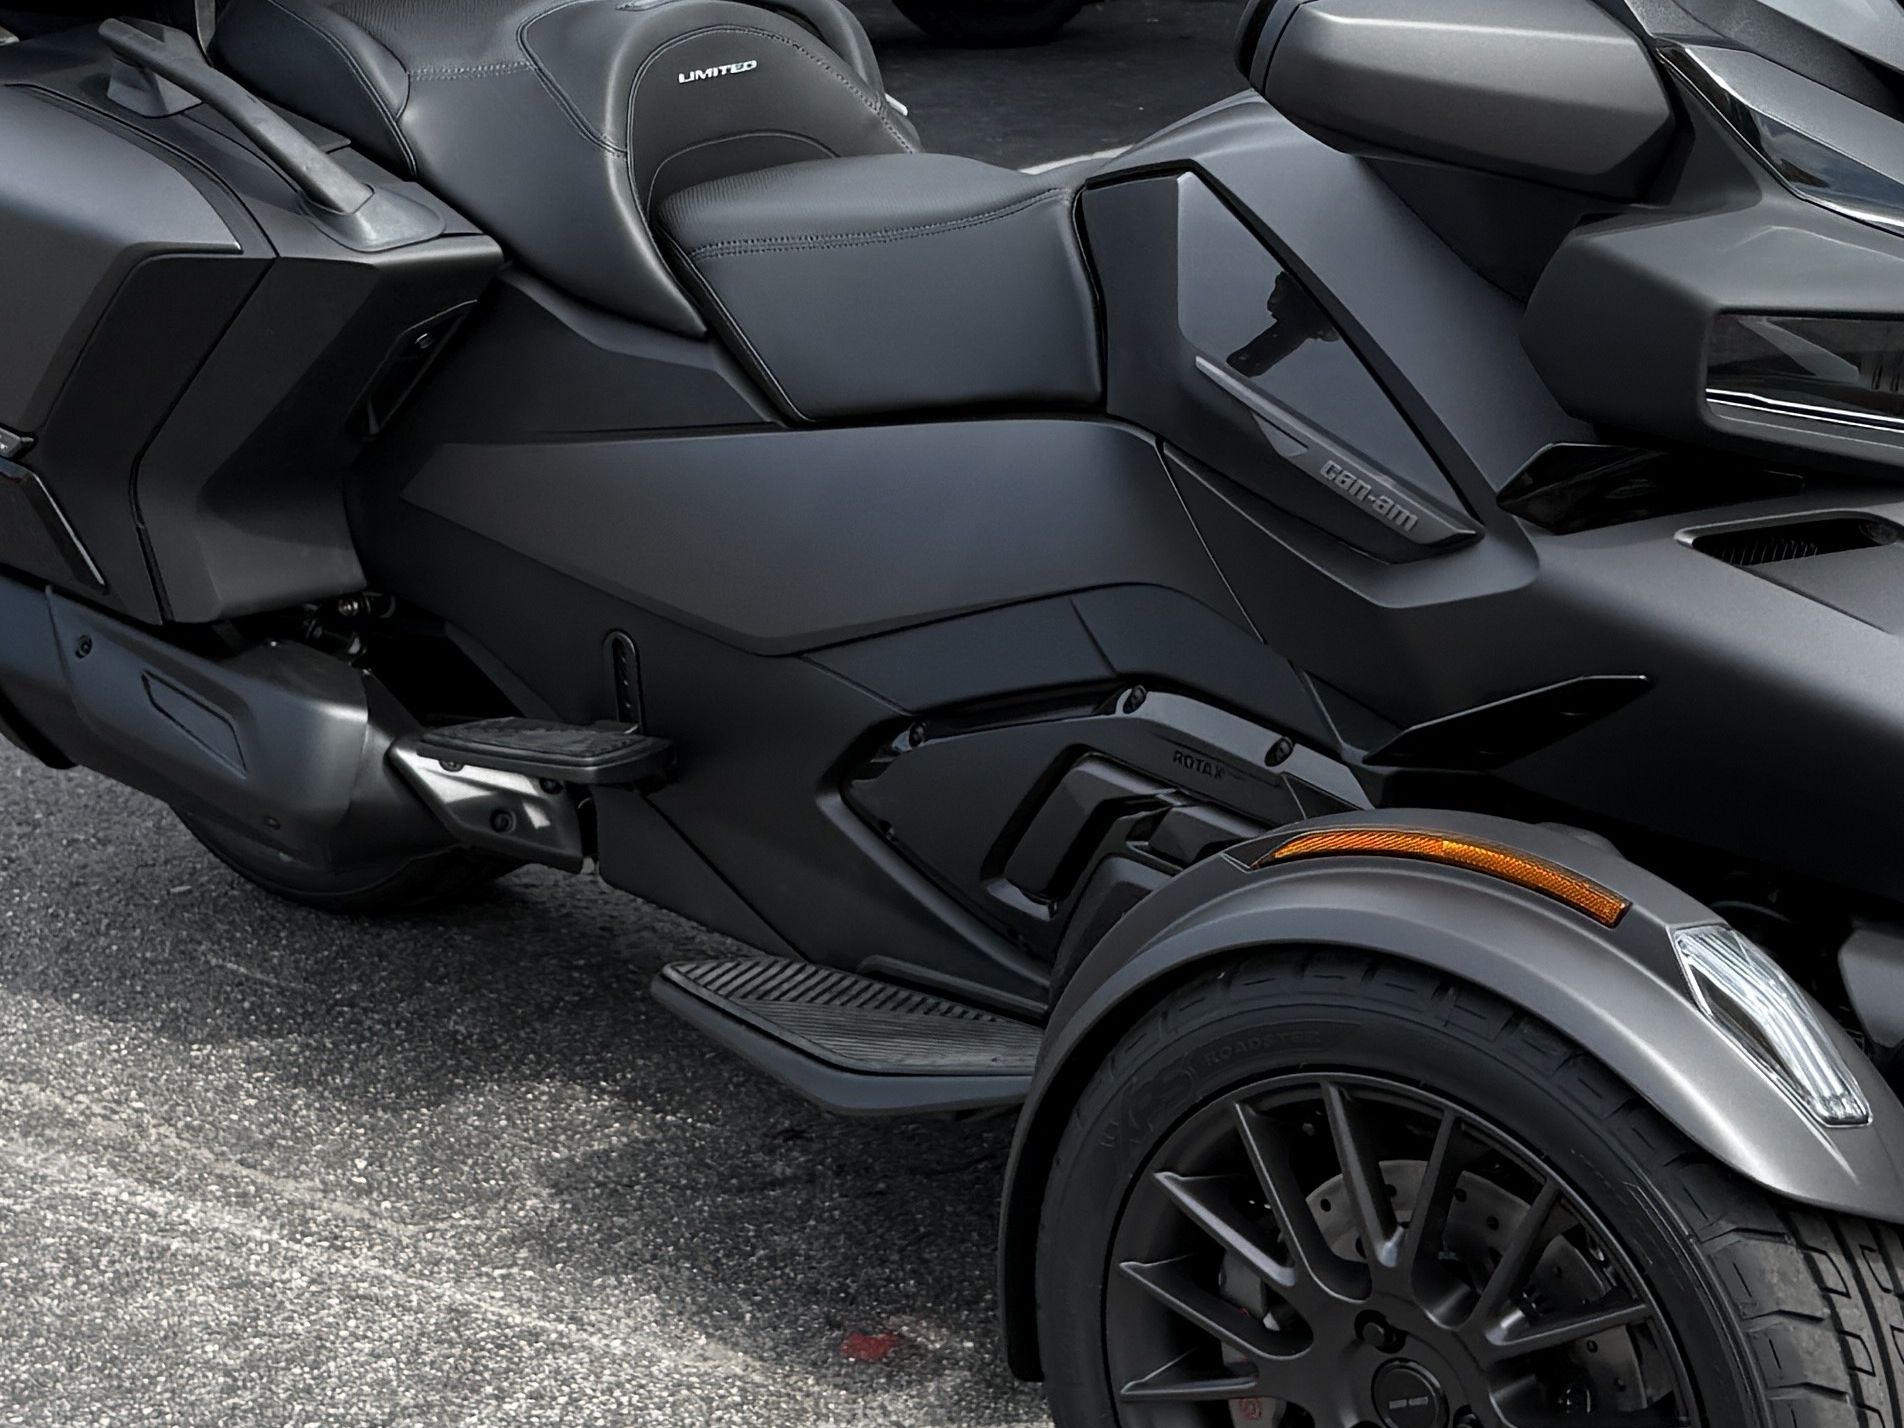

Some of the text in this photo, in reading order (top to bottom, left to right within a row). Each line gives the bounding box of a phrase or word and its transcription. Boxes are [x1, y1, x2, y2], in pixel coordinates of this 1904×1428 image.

[678, 59, 758, 84] LIMITED
[1320, 459, 1418, 532] can-am
[1172, 749, 1225, 781] ROTAX
[1203, 1030, 1322, 1068] ROADSTER
